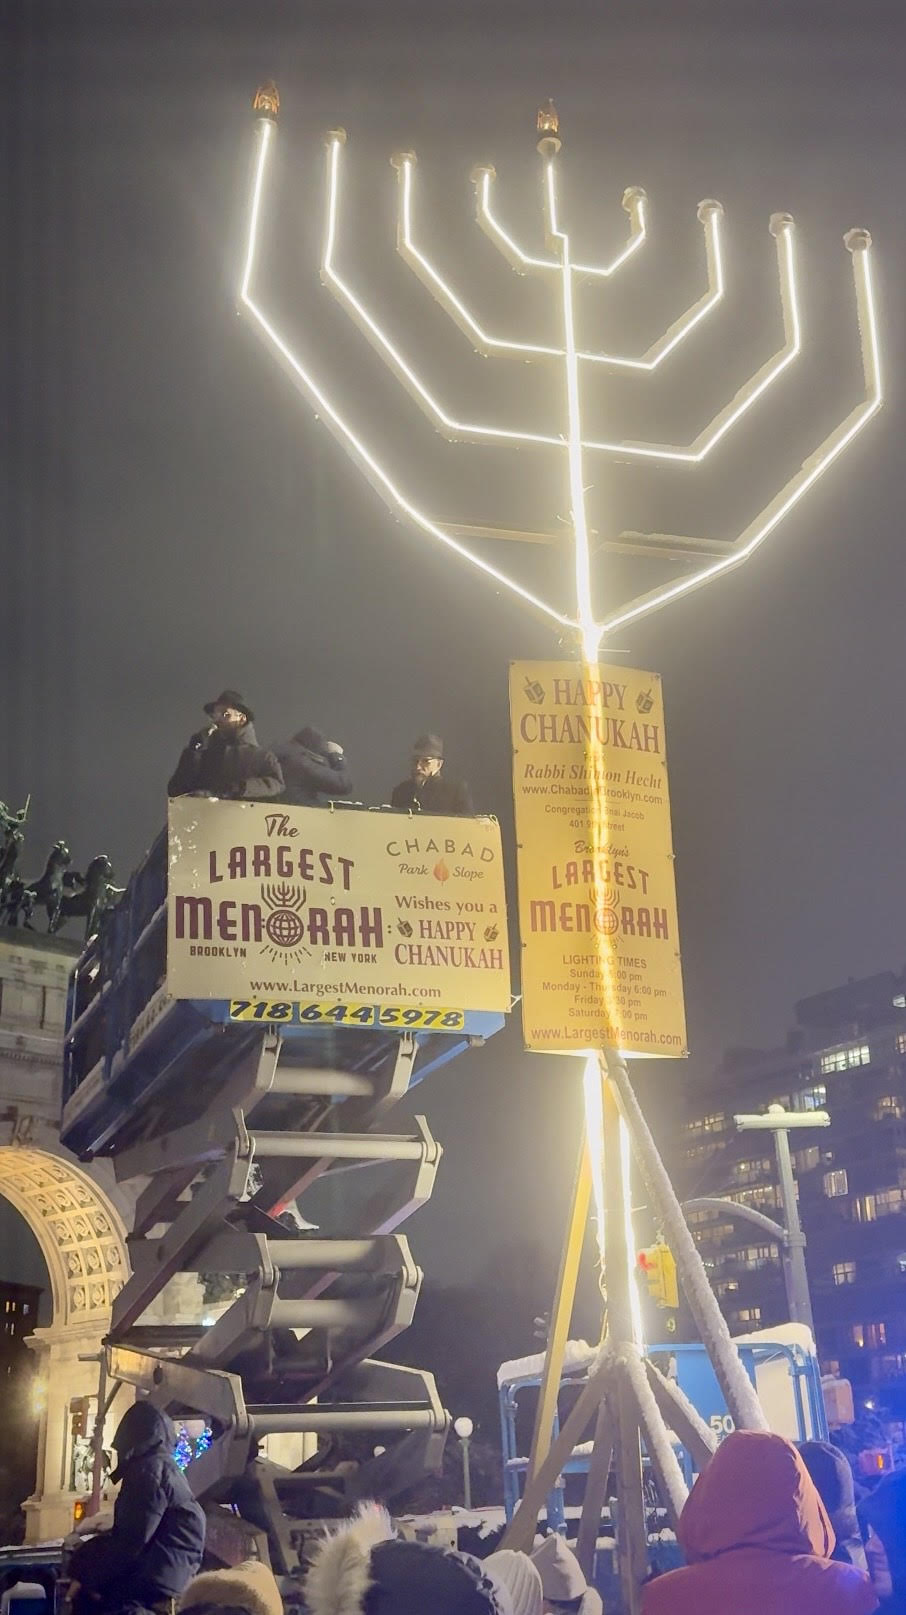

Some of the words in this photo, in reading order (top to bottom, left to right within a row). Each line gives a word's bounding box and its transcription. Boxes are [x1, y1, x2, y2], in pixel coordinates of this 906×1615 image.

[553, 679, 627, 710] HAPPY
[520, 713, 660, 754] CHANUKAH
[524, 763, 565, 779] Rabbi
[625, 770, 661, 789] Hecht
[545, 804, 600, 816] Congregatio
[265, 813, 299, 838] The
[569, 820, 583, 828] 401
[386, 838, 495, 862] CHABAD
[574, 840, 629, 858] Brolyn's
[209, 844, 355, 891] LARGEST
[398, 864, 429, 876] Park
[453, 866, 484, 882] Slope
[552, 859, 649, 895] LARGEST
[395, 895, 451, 911] Wishes
[456, 901, 484, 915] you
[489, 903, 497, 913] a
[175, 895, 384, 948] MENORAH
[530, 900, 669, 940] MENORAH
[419, 920, 476, 941] HAPPY
[190, 945, 246, 958] BROOKLYN
[325, 951, 346, 962] NEW
[352, 952, 377, 963] YORK
[394, 943, 503, 970] CHANUKAH
[617, 956, 647, 968] TIMES
[569, 968, 604, 980] Sunday
[629, 973, 642, 981] pm
[250, 980, 441, 998] www.LargestMenorah.com
[542, 982, 580, 993] Monday
[589, 982, 632, 995] Thusday
[654, 988, 667, 997] pm
[574, 995, 604, 1007] Friday
[628, 998, 641, 1008] pm
[231, 1002, 291, 1019] 718
[300, 1004, 374, 1023] 644
[379, 1007, 464, 1026] 5978
[568, 1007, 610, 1019] Saturday
[634, 1012, 648, 1021] pm
[531, 1026, 682, 1045] www.LargestMenorah.com
[711, 1415, 735, 1434] 50
